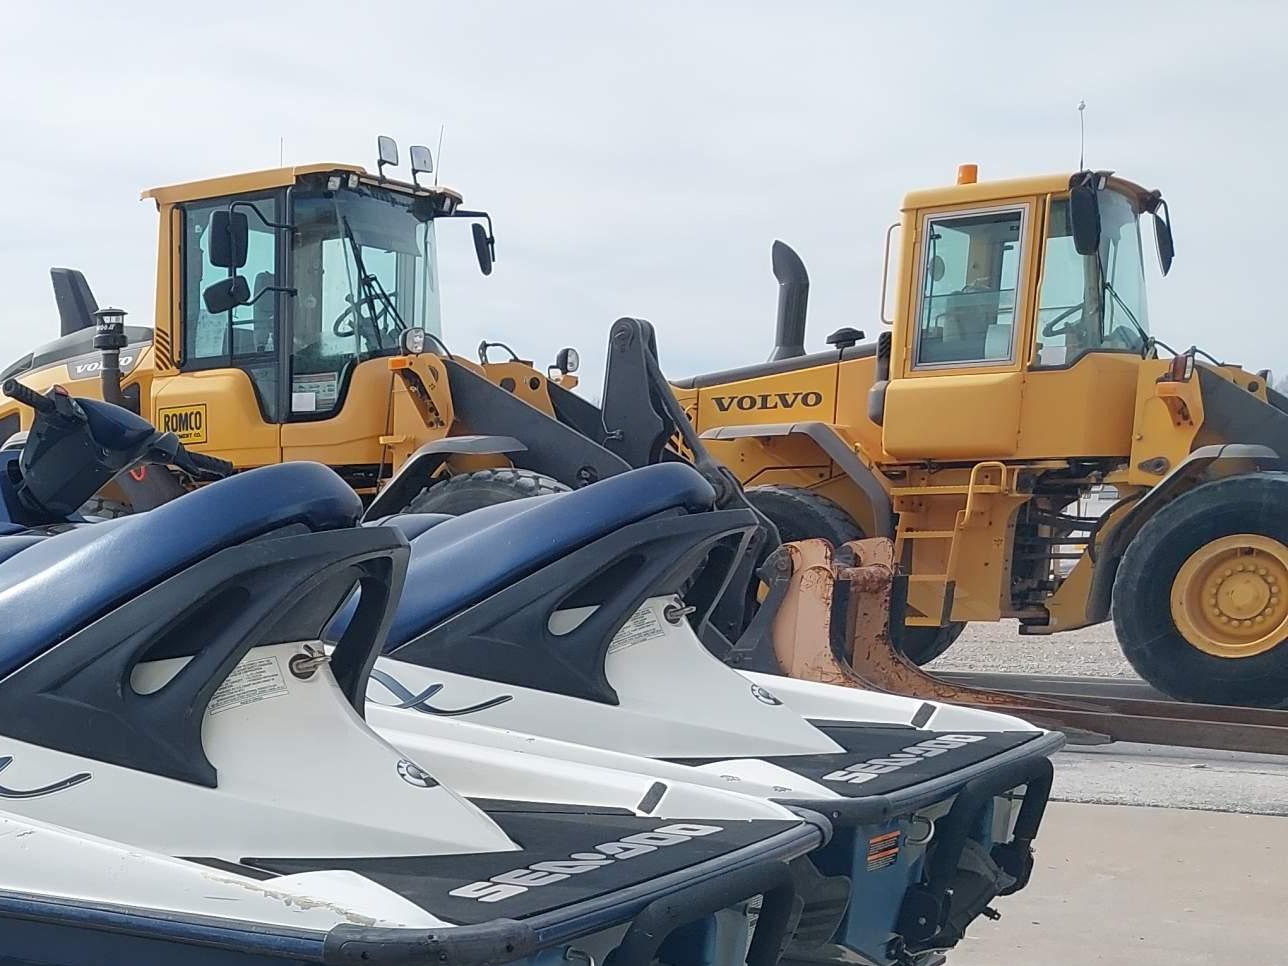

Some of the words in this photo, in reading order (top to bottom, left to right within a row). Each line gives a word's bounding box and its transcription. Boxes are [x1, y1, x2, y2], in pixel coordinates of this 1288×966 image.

[76, 356, 133, 373] VOO
[711, 391, 823, 412] VOLVO
[163, 411, 202, 433] ROMCO
